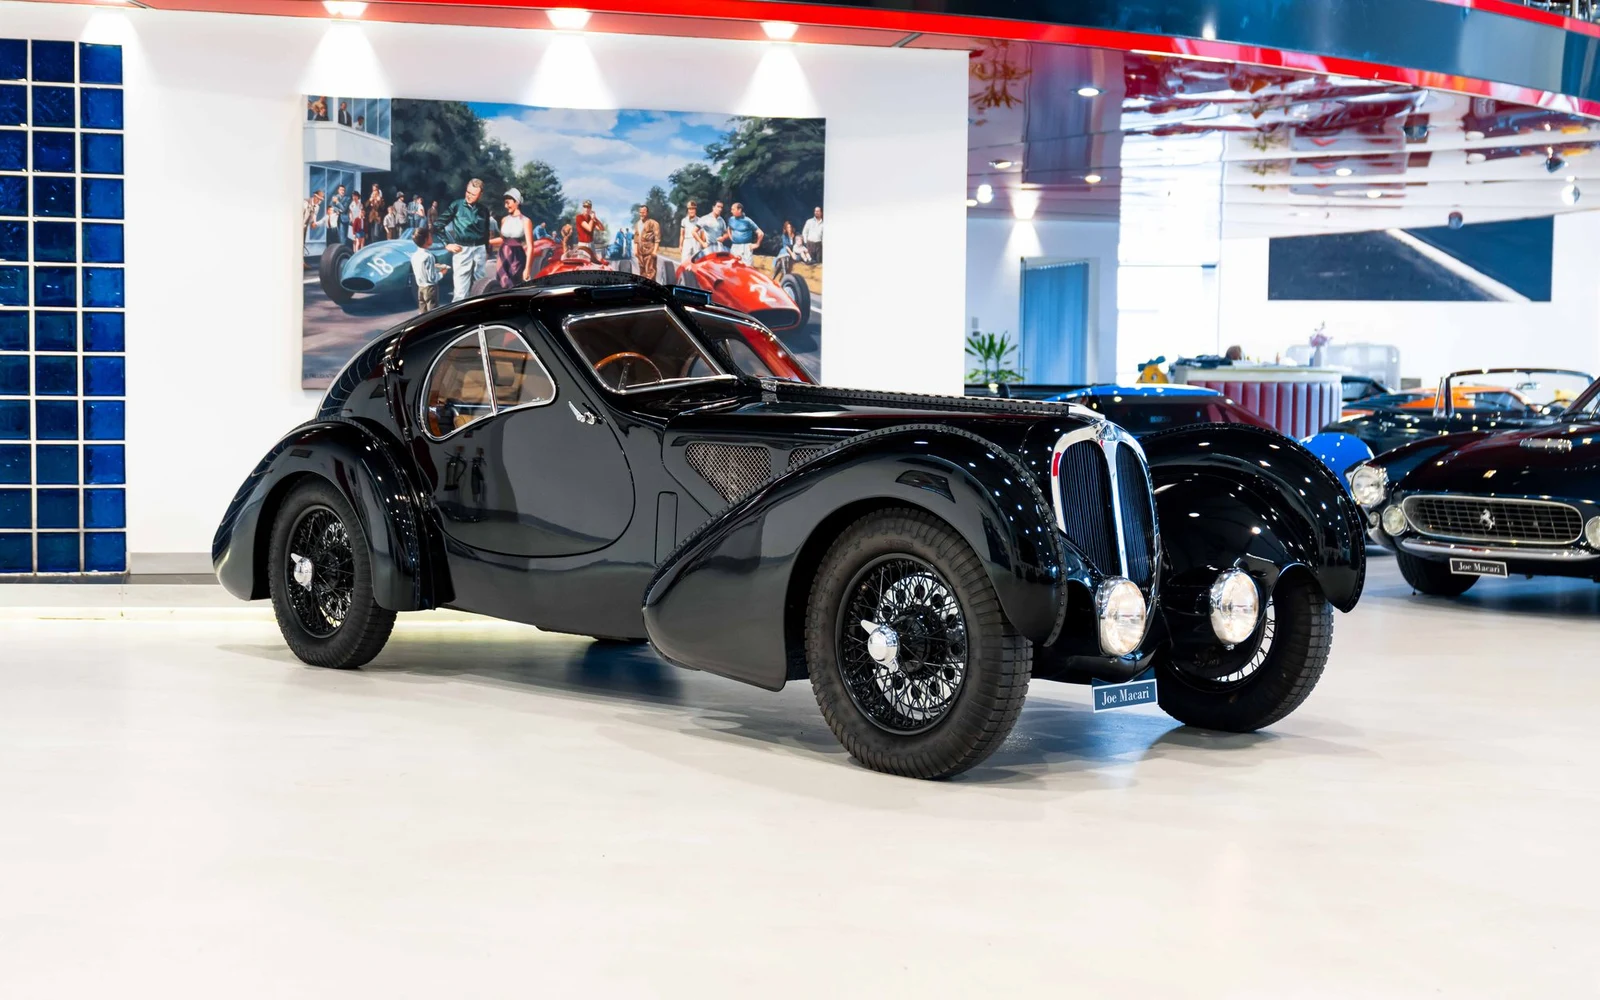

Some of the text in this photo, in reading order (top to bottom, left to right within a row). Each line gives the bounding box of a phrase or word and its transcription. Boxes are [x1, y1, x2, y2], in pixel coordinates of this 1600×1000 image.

[366, 256, 394, 276] 18
[749, 284, 777, 302] 2
[1458, 561, 1500, 573] Joe Macari
[1101, 686, 1150, 706] Joe Macari
